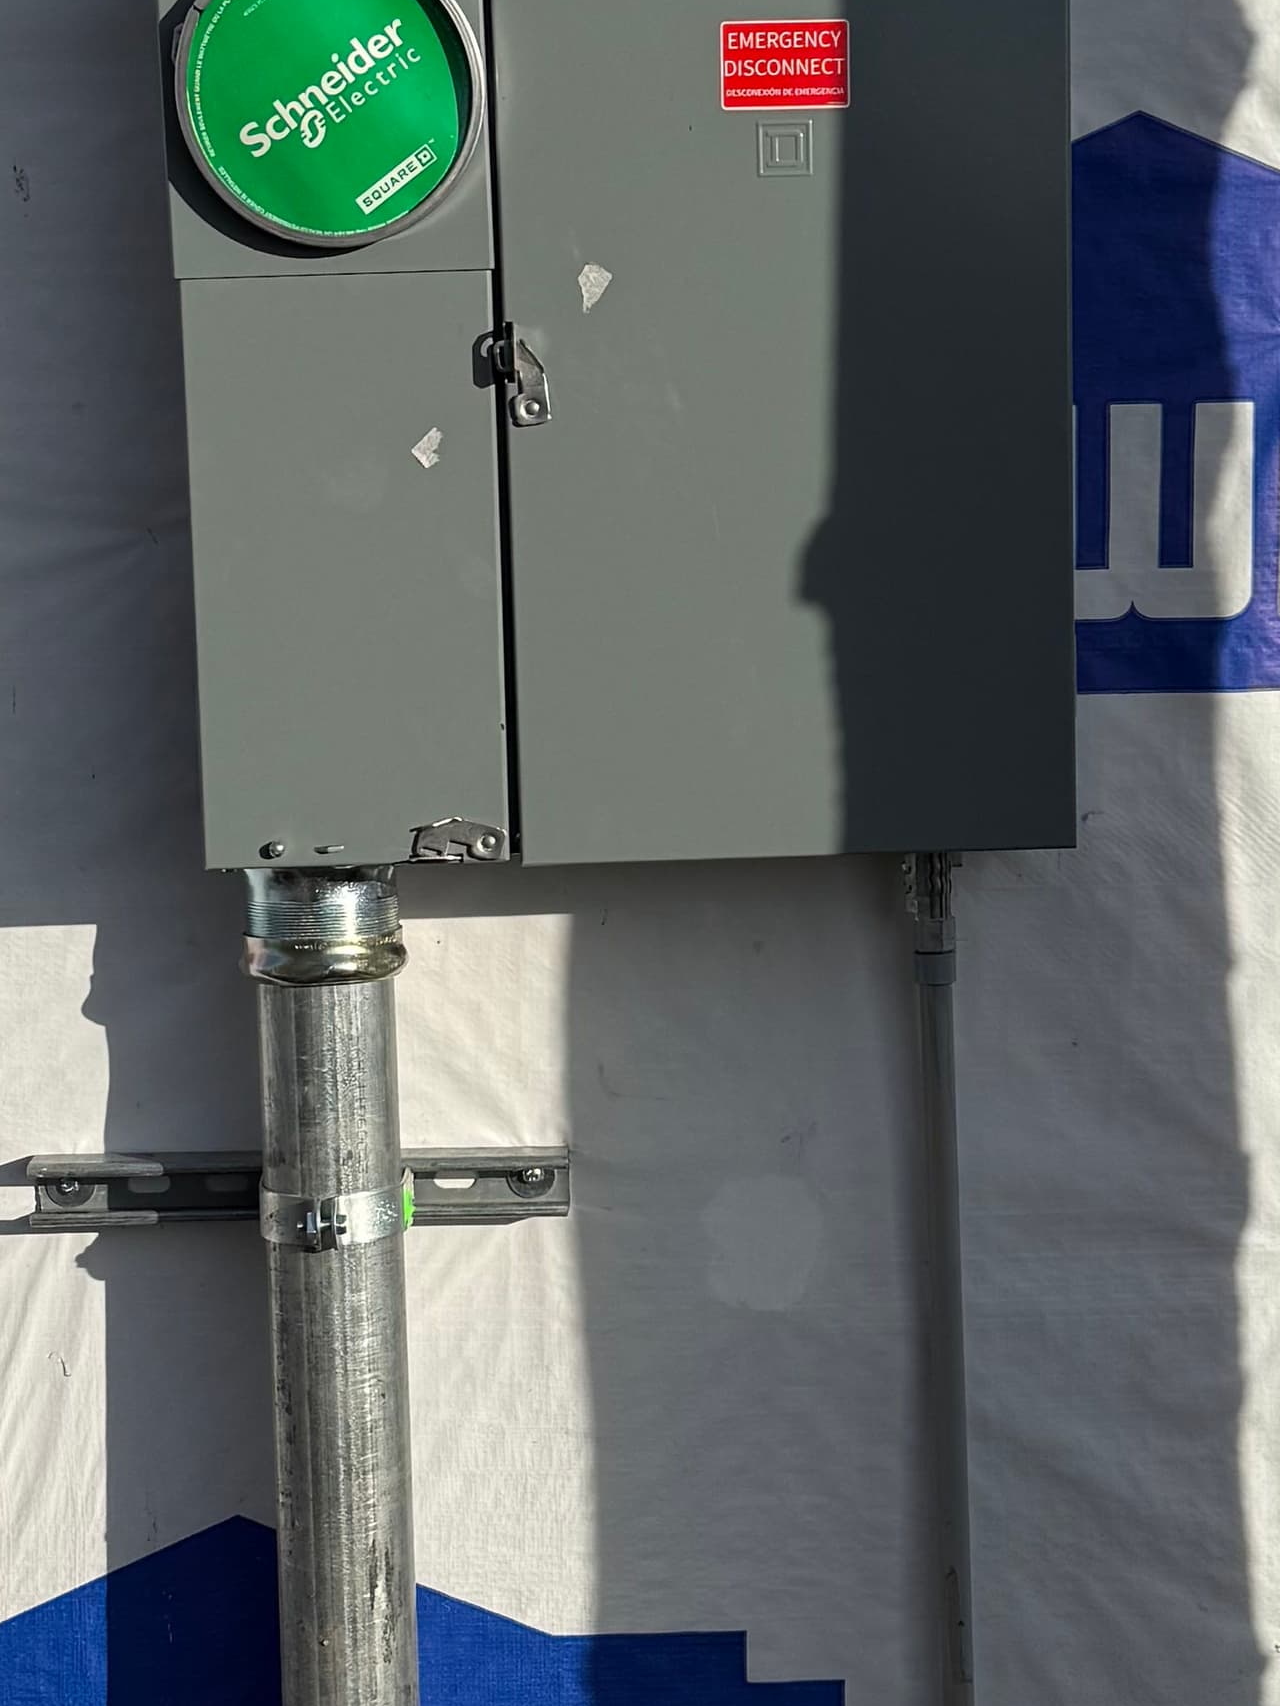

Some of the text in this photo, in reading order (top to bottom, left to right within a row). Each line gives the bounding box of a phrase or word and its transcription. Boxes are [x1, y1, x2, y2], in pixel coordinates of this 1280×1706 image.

[727, 30, 841, 50] EMERGENCY
[239, 18, 404, 158] Schneider
[324, 46, 421, 124] Electric
[724, 58, 846, 77] DISCONNECT
[362, 160, 418, 207] SQUARE
